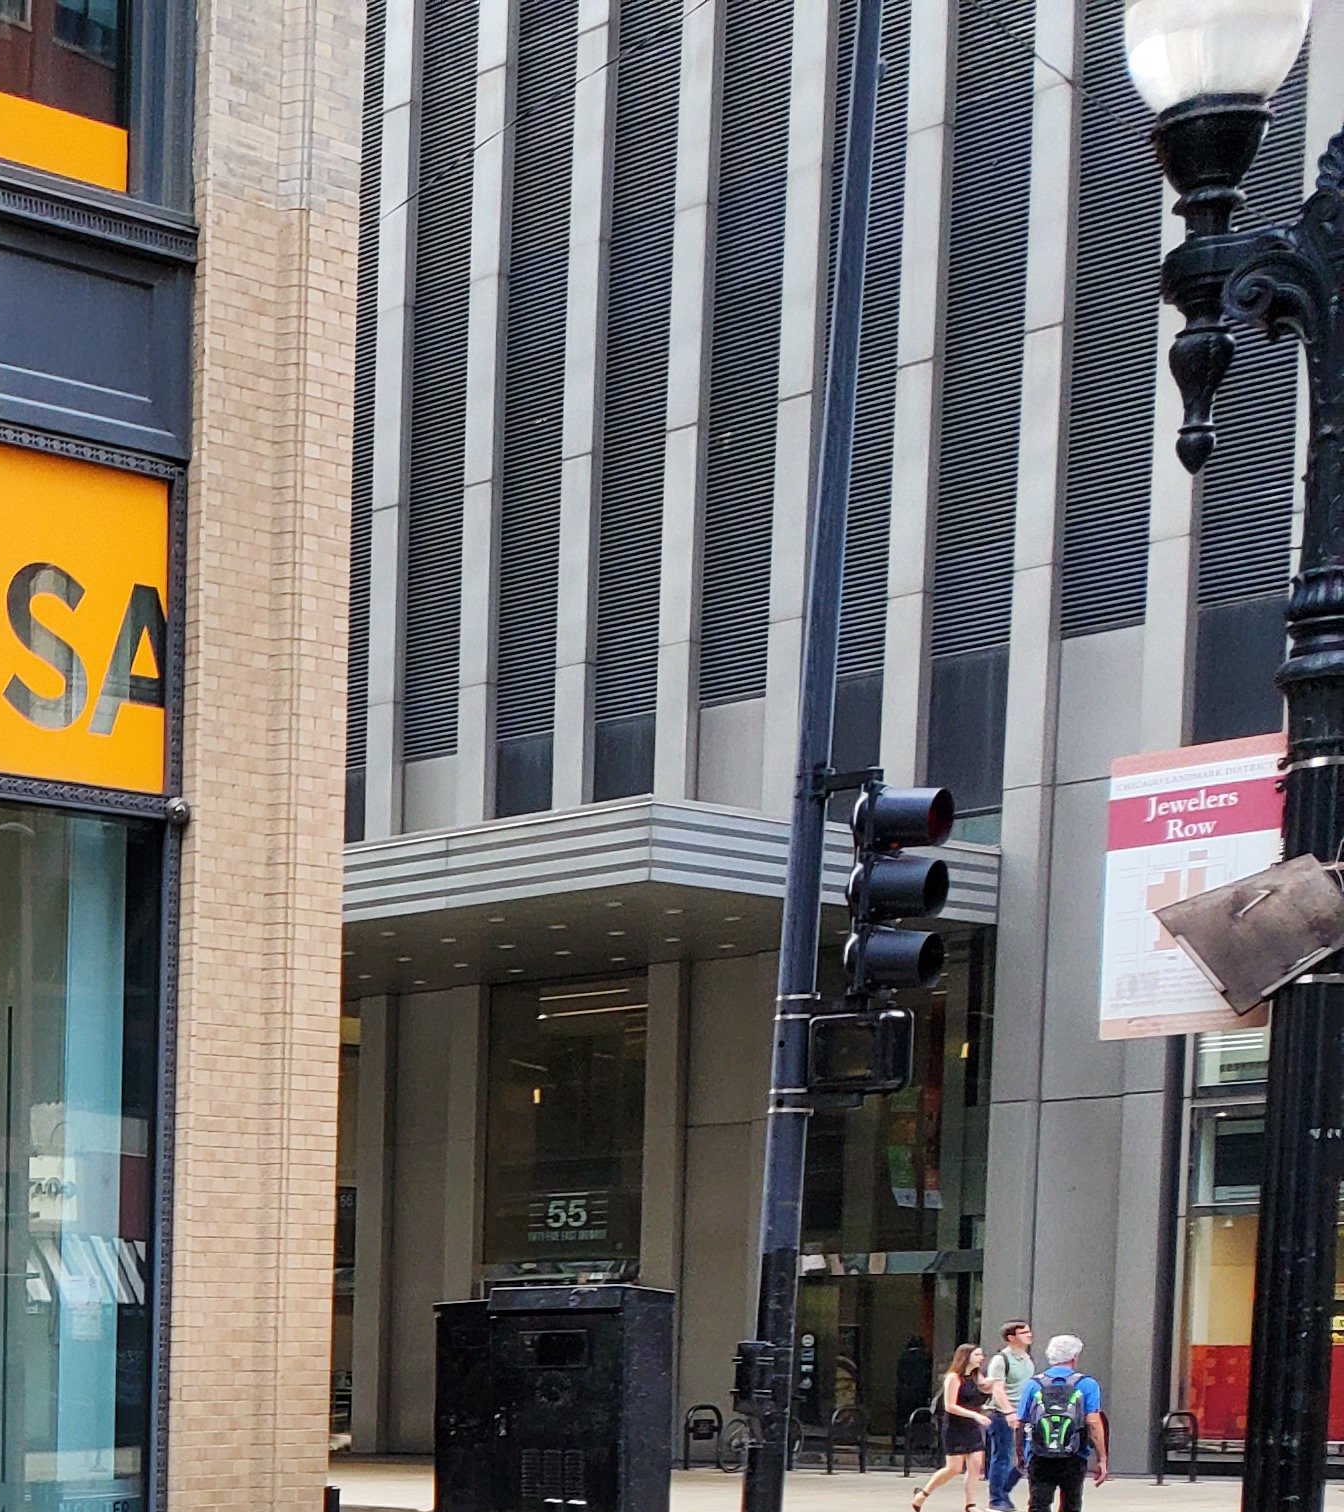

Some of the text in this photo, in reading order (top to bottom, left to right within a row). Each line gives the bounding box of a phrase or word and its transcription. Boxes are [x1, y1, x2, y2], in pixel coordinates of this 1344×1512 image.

[1116, 760, 1275, 792] CHICAGO LANDMARK DISTRICT
[1144, 788, 1239, 822] Jewelers
[1166, 818, 1217, 840] Row
[546, 1199, 587, 1228] 55
